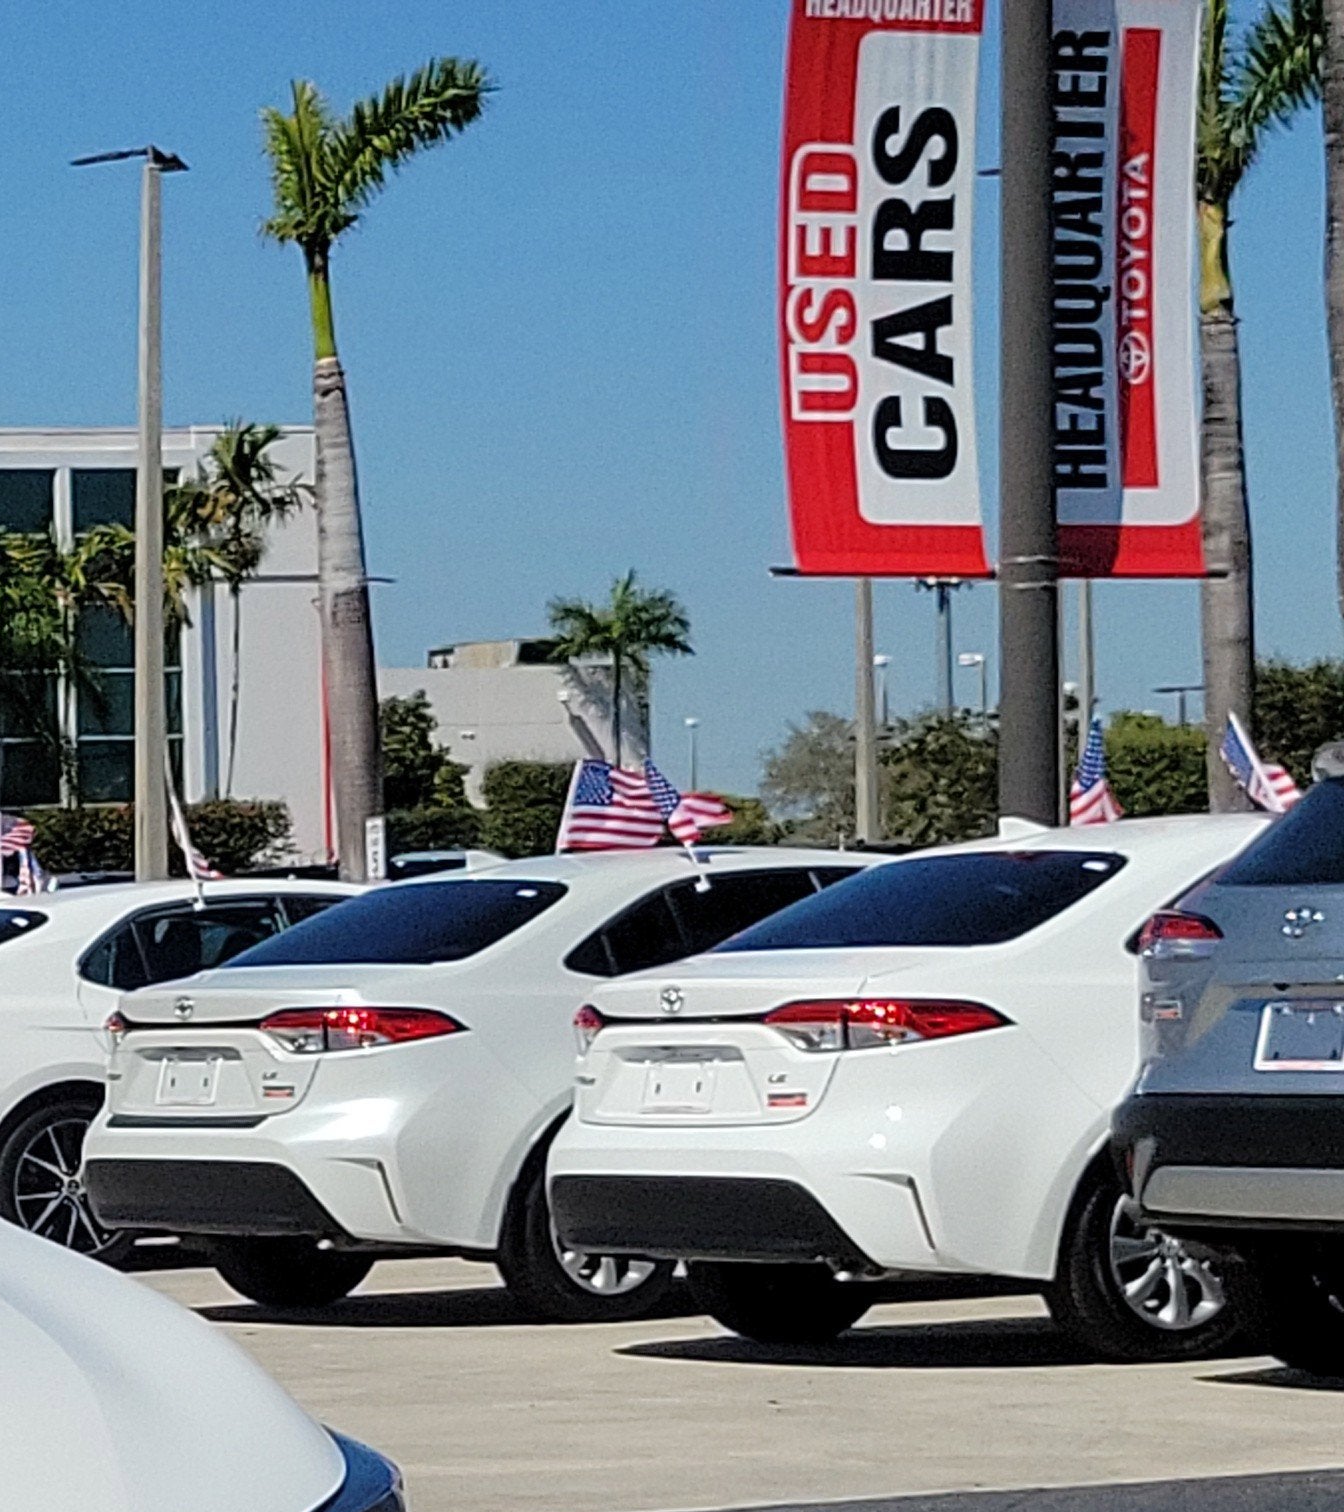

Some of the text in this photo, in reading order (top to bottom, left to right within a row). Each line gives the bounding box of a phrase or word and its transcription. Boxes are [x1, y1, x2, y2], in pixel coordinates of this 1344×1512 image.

[805, 0, 974, 23] HEADQUARTER
[791, 146, 858, 418] USED
[871, 104, 960, 481] CARS
[1053, 30, 1111, 490] HEADQUARTER
[1120, 152, 1150, 326] TOYOTA
